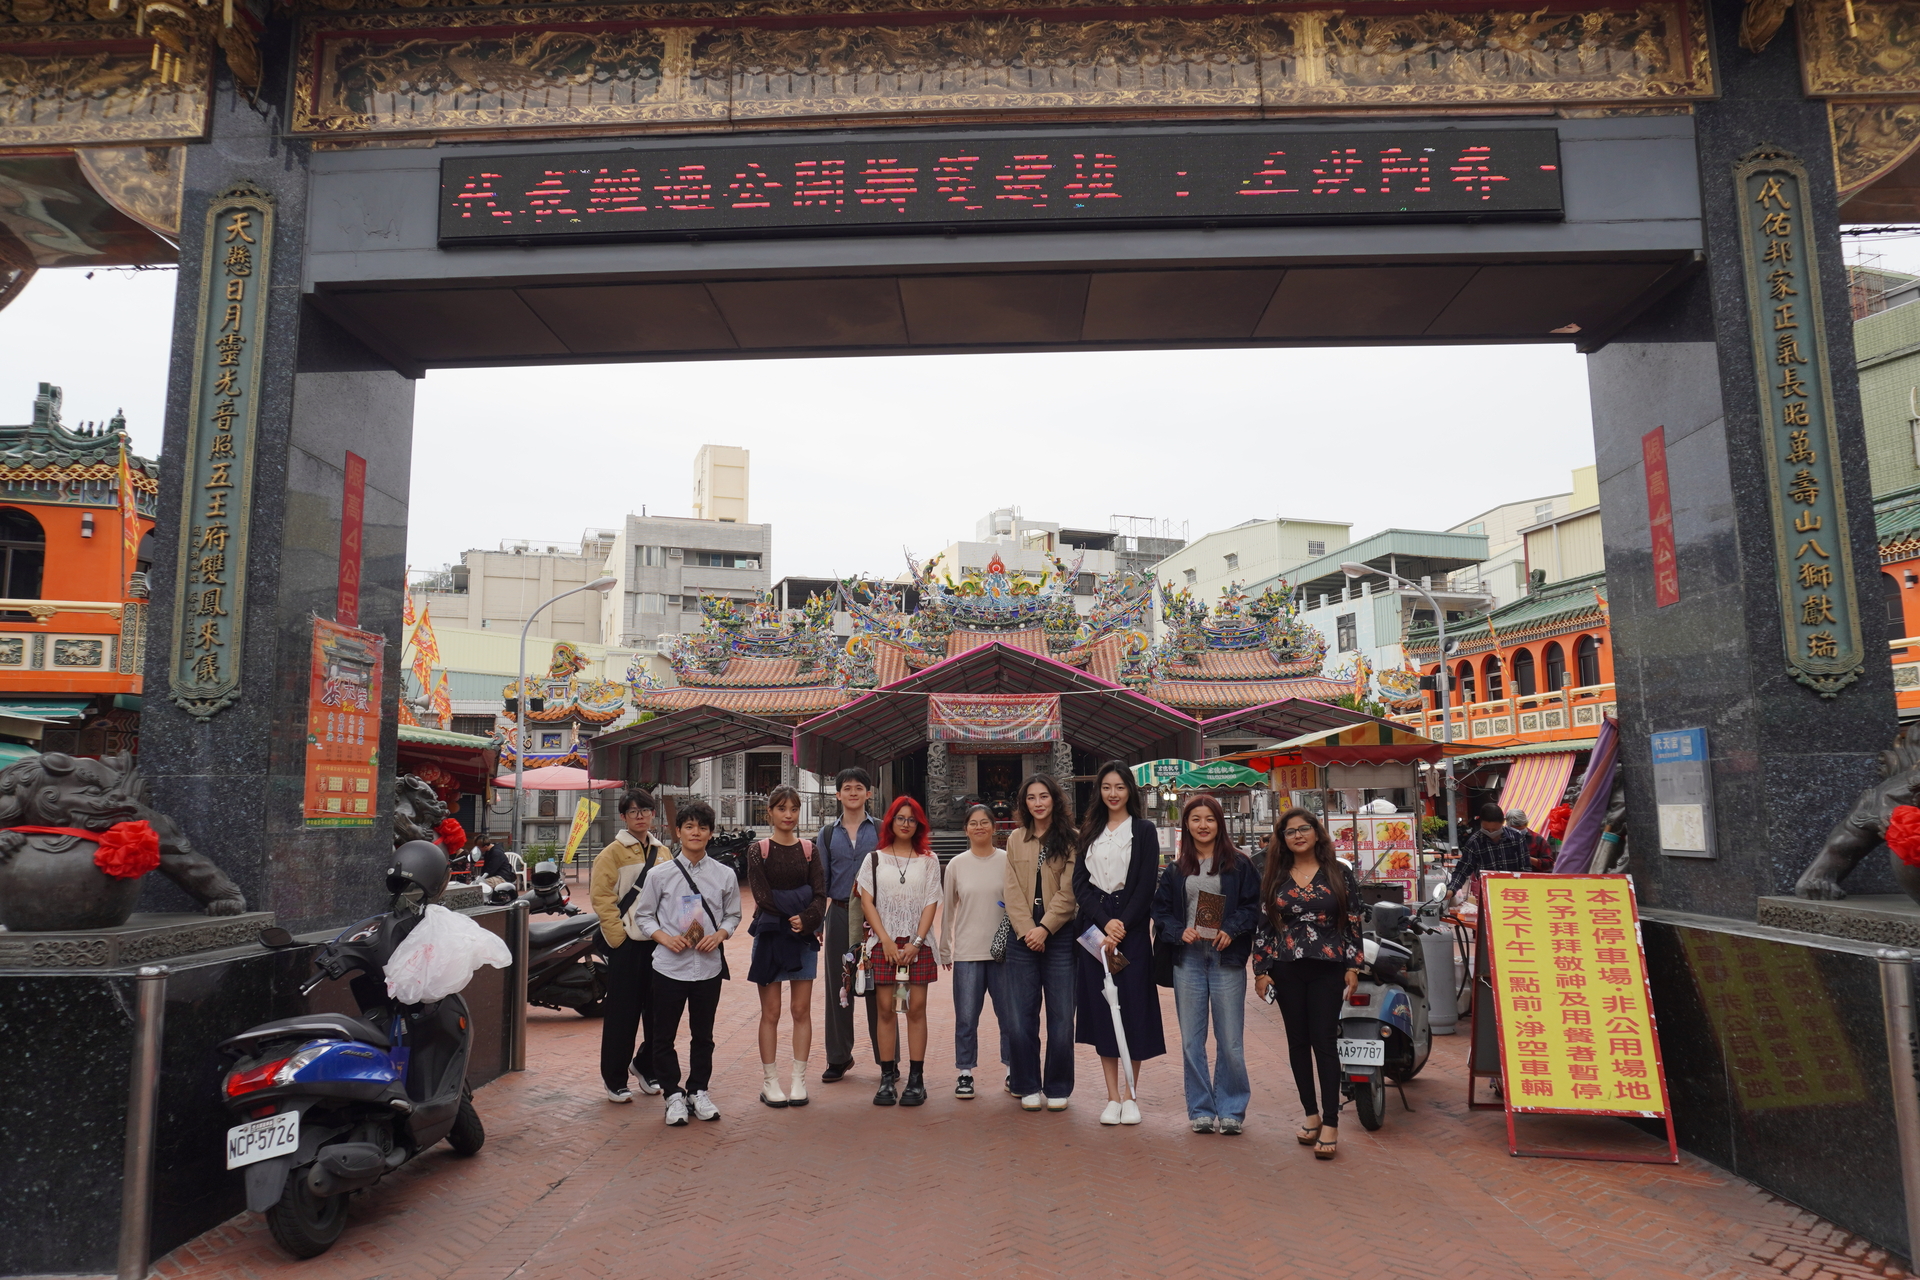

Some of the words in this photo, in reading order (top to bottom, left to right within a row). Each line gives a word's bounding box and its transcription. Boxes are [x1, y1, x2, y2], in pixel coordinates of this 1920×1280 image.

[1755, 177, 1838, 658] 代佑邦家正氣長昭萬壽山八獅獻瑞
[339, 459, 364, 621] 限高4公尺
[1645, 436, 1677, 598] 限高4公尺
[1654, 736, 1678, 751] 代天宮
[1546, 888, 1603, 1100] 只予拜拜敬神及用餐者暫停
